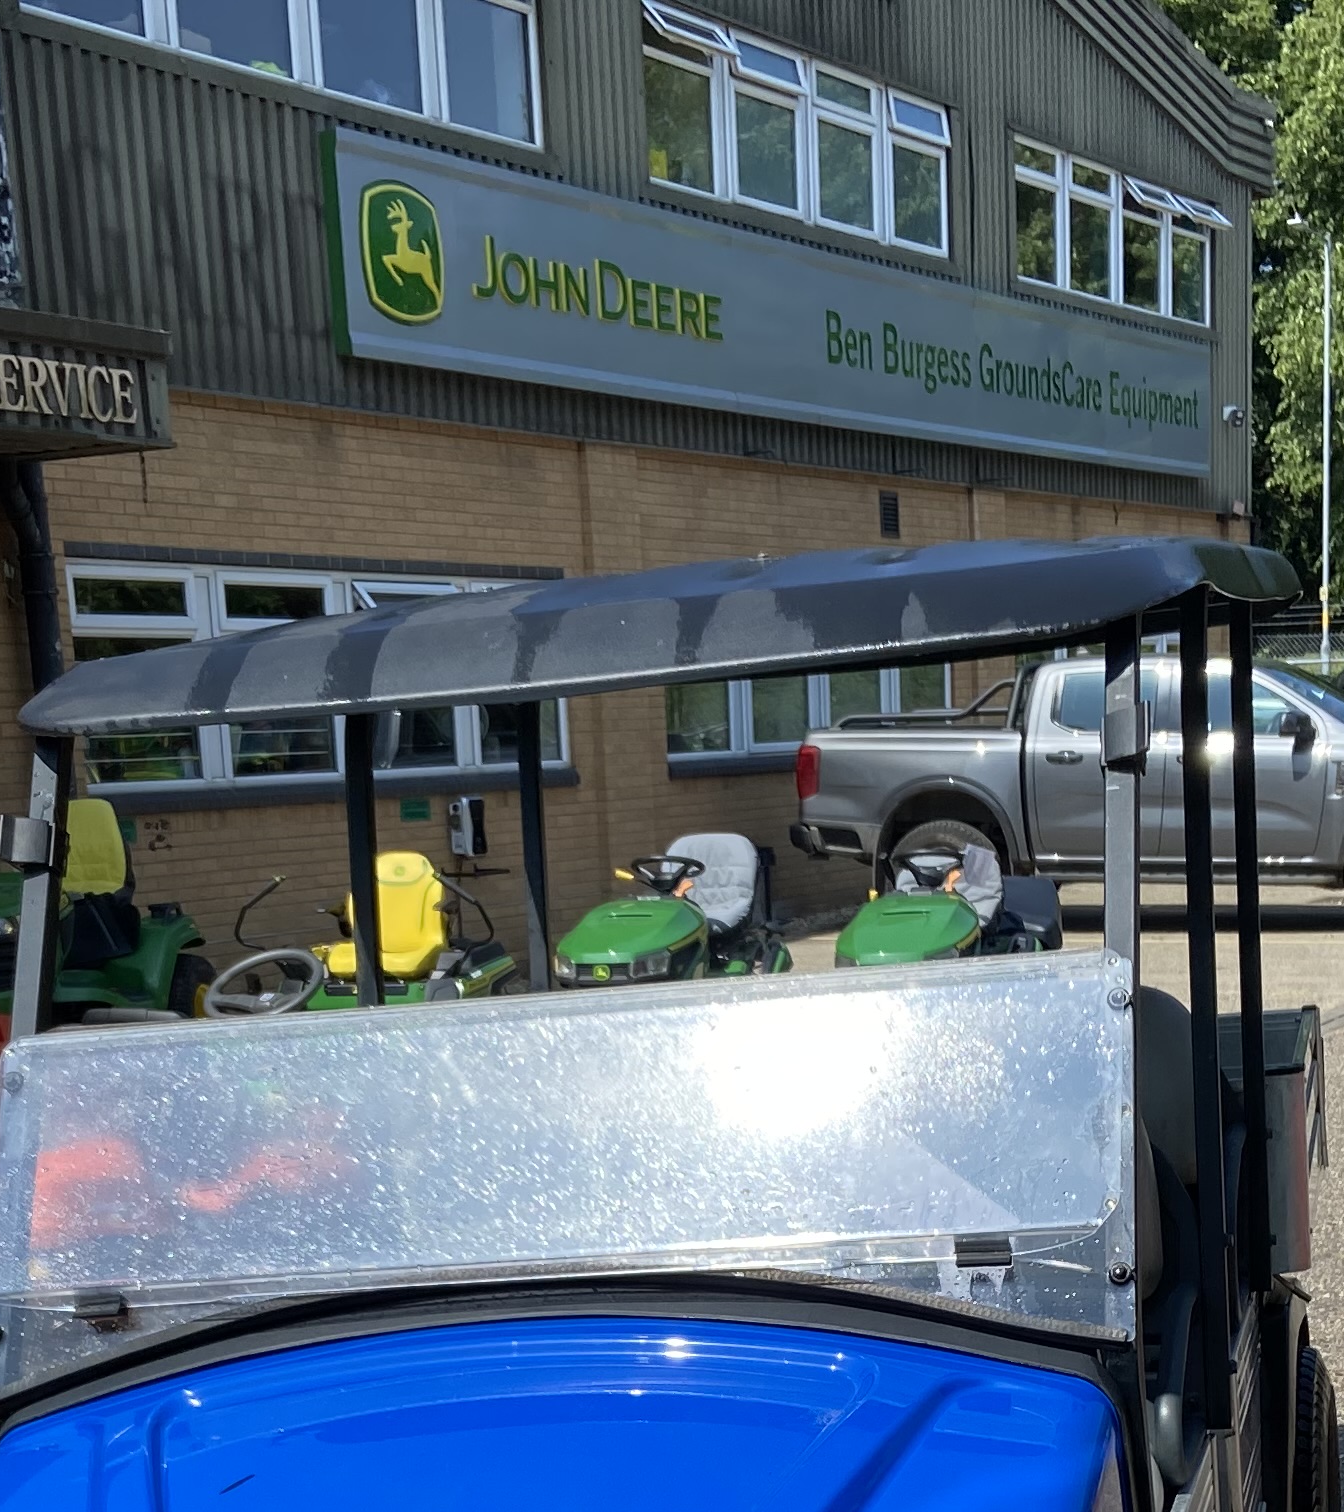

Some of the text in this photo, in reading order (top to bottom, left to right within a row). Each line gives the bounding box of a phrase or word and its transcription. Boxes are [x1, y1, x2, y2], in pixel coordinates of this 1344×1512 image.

[471, 234, 724, 342] JOHN DEERE
[825, 308, 1200, 432] Ben Burgess GroundsCare Equipment
